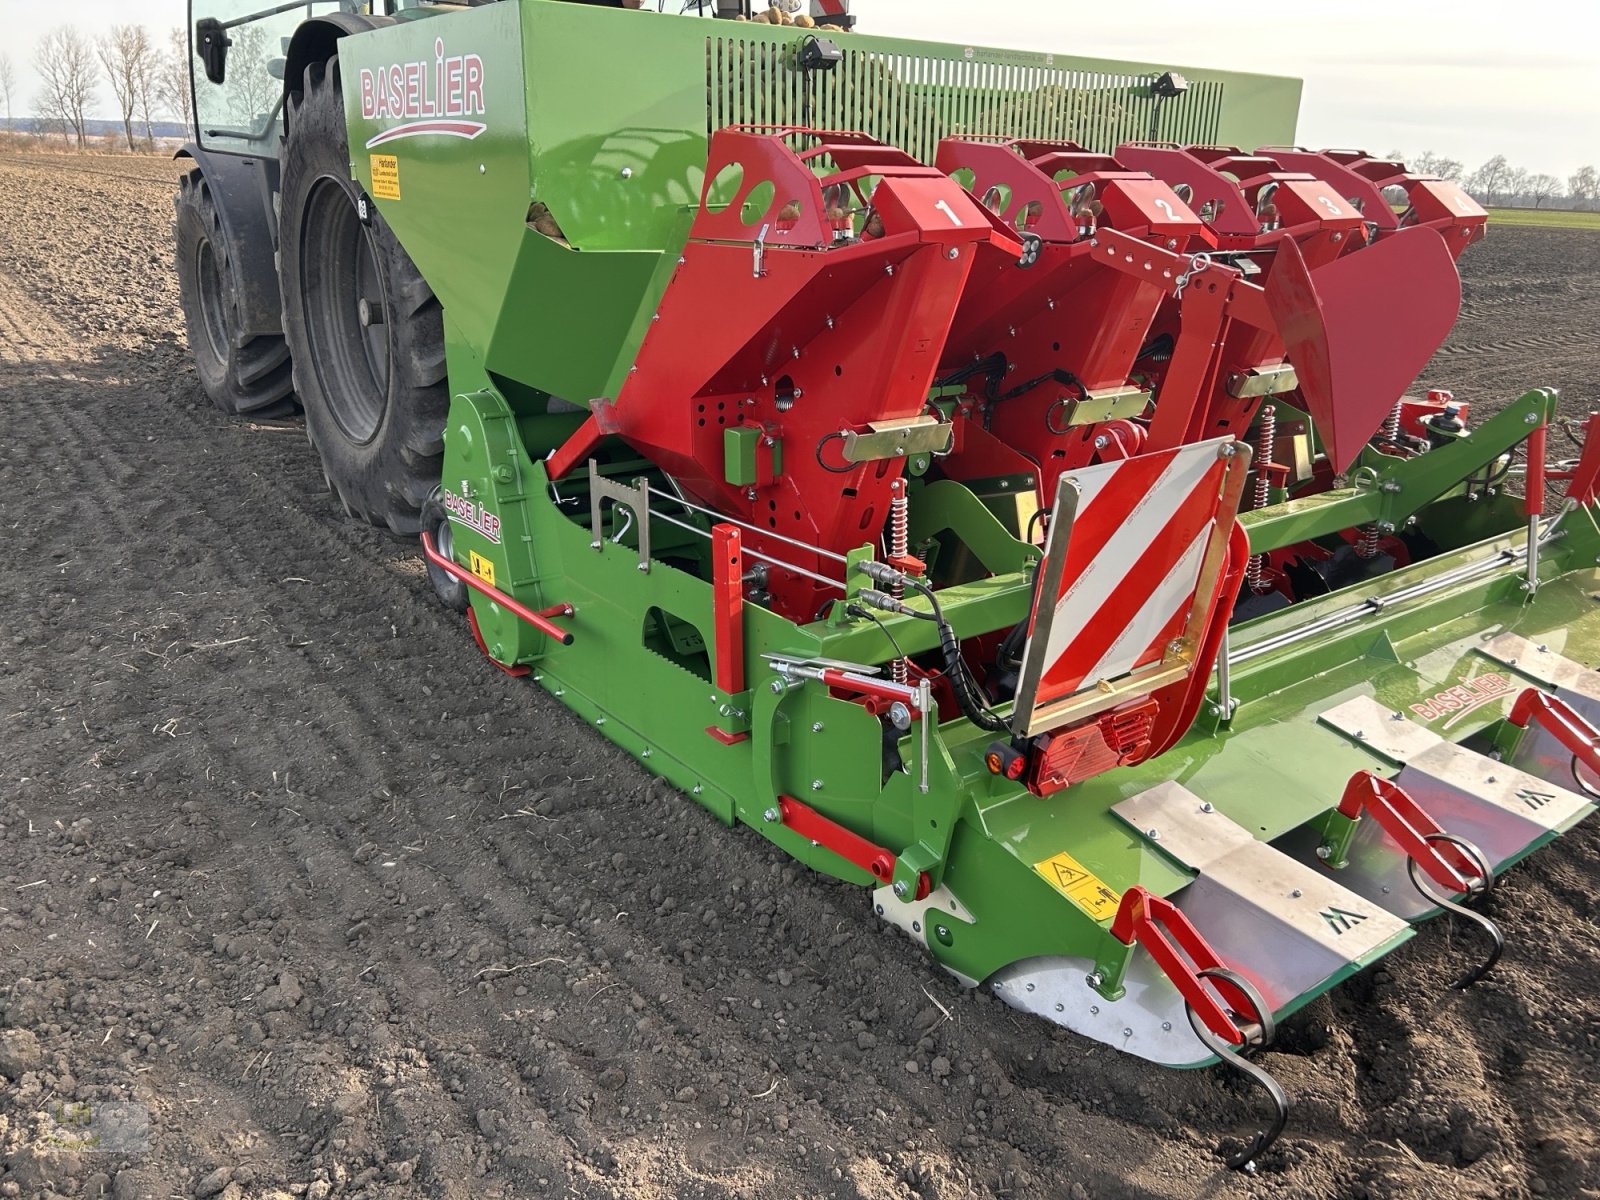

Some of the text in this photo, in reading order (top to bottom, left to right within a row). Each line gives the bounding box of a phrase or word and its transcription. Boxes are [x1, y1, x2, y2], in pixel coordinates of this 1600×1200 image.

[934, 200, 963, 226] 1
[1154, 199, 1183, 221] 2
[1318, 196, 1342, 215] 3
[1454, 195, 1473, 213] 4
